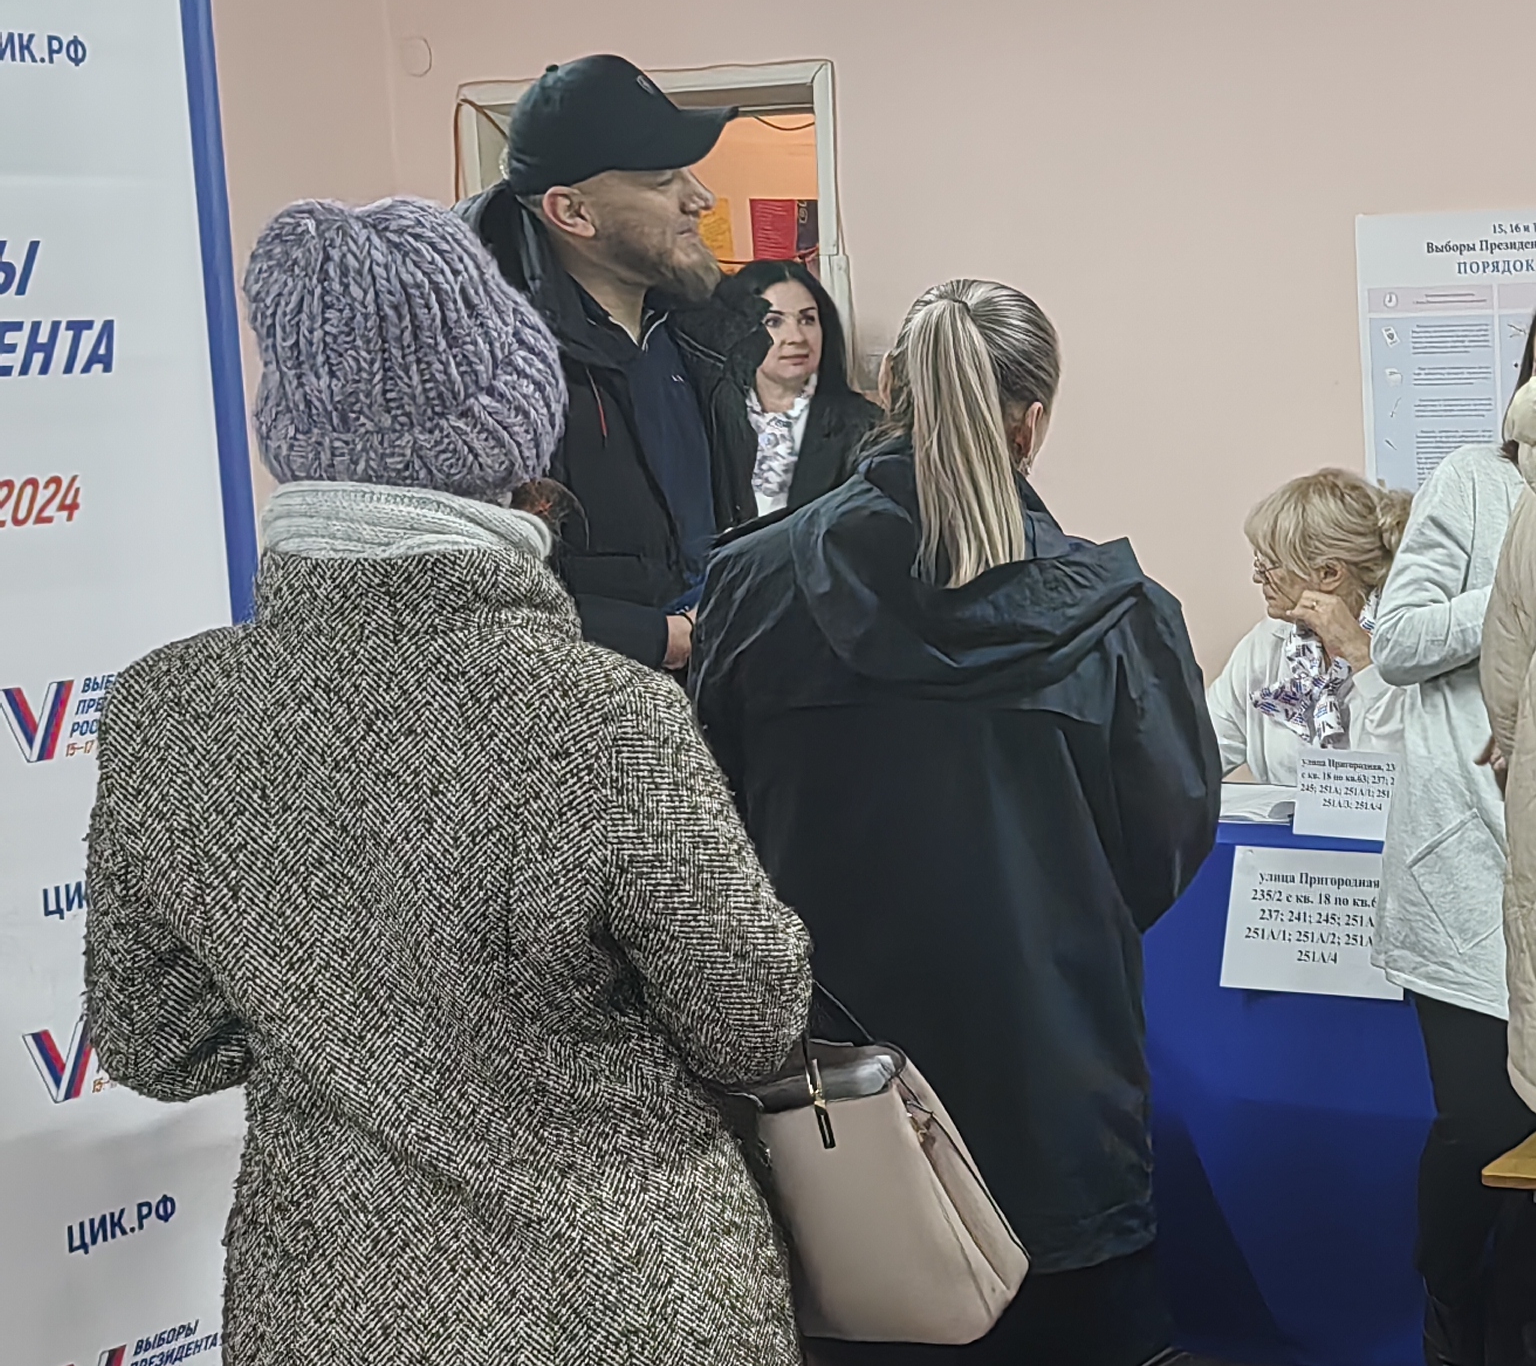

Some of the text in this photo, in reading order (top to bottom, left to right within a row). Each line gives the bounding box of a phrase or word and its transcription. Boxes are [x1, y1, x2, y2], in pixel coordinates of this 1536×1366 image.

[0, 31, 87, 67] ИК.РФ
[1492, 223, 1507, 235] 15,
[1509, 222, 1521, 234] 16
[1523, 224, 1531, 233] и
[1426, 240, 1477, 255] Выборы
[1457, 258, 1535, 276] ПОРЯДОК
[0, 318, 115, 377] ЕНТА
[75, 696, 108, 715] ПРЕ
[69, 718, 99, 739] РОС
[1385, 762, 1396, 772] 23
[1376, 788, 1390, 799] 251
[1259, 872, 1380, 890] улица Пригородная
[42, 881, 86, 920] ЦИ
[1251, 889, 1377, 908] 235/2 с кв. 18 по кв.6
[1259, 908, 1375, 928] 237; 241; 245; 251А
[1244, 926, 1373, 947] 251А/1; 251А/2; 251А
[1297, 949, 1338, 964] 251А/4
[67, 1193, 176, 1255] ЦИК.РФ
[133, 1319, 200, 1357] ВЫБОРЫ
